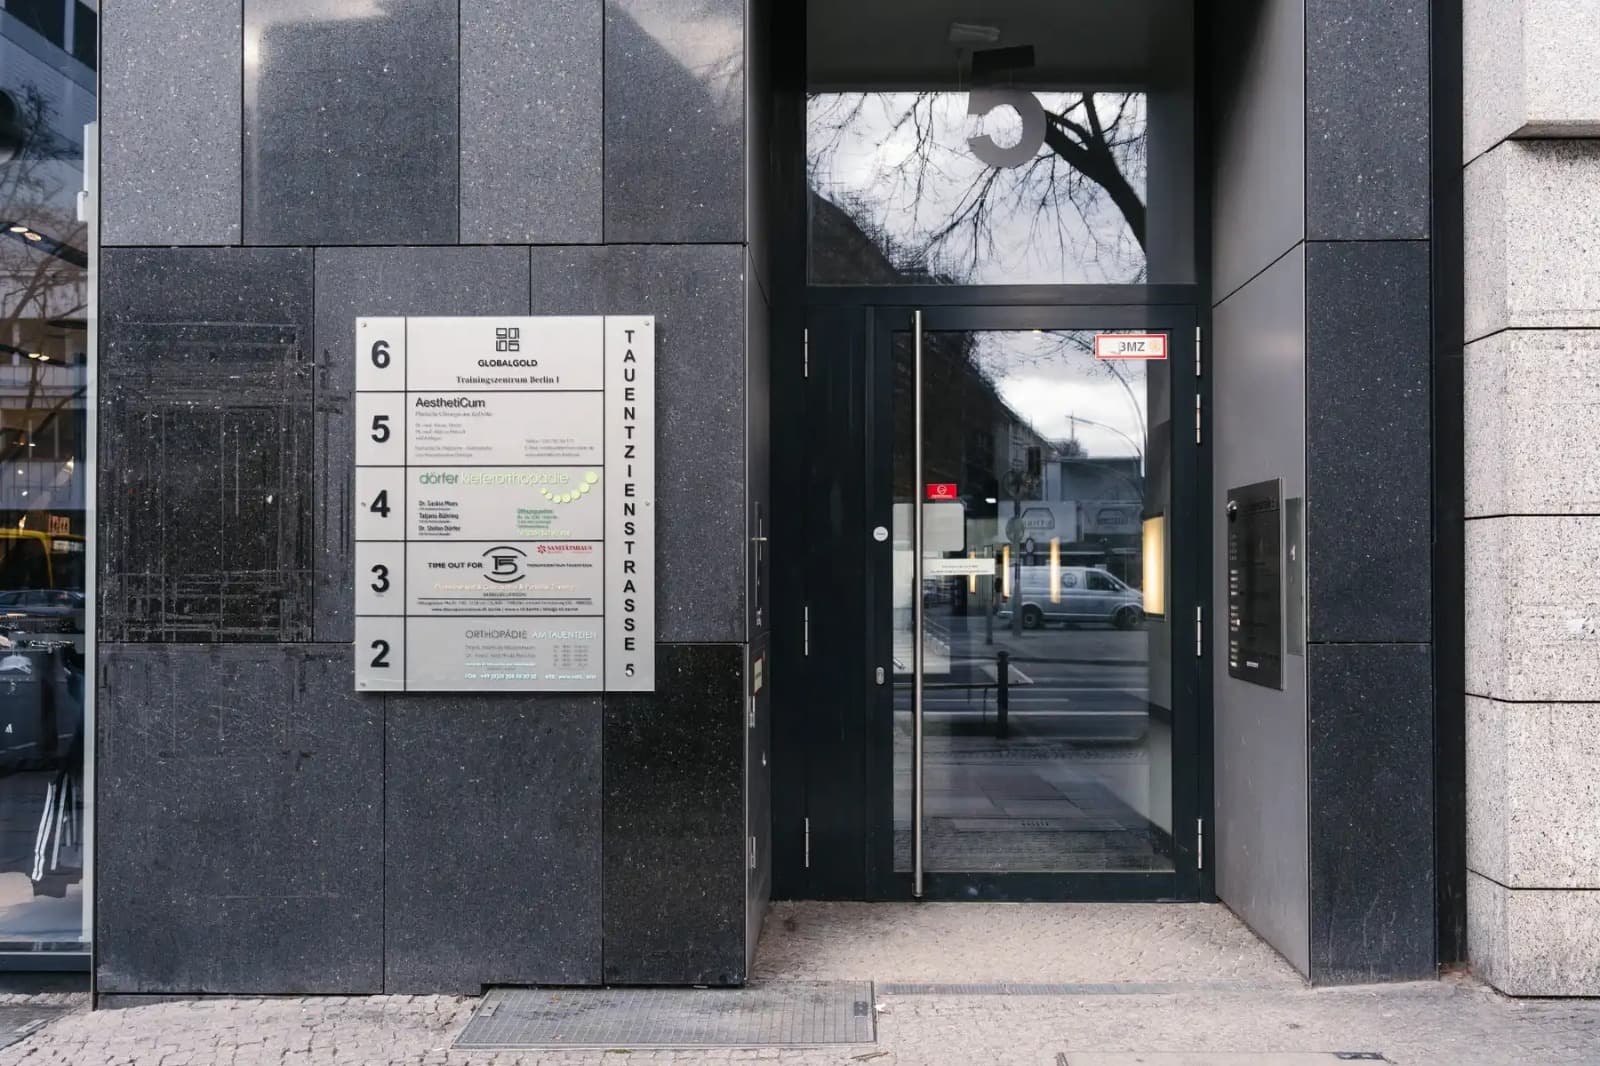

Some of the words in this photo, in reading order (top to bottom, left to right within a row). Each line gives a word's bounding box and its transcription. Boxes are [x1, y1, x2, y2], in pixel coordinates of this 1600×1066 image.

[966, 44, 1047, 169] 5
[371, 340, 390, 368] 6
[477, 359, 538, 367] GLOBALGOLD
[415, 397, 486, 408] AesthetiCum
[371, 415, 390, 443] 5
[419, 471, 459, 485] dörfer
[623, 330, 636, 651] TAUENTZIENSTRASSE
[370, 490, 390, 517] 4
[370, 564, 390, 592] 3
[465, 629, 528, 640] ORTHOPÄDIE
[370, 639, 390, 667] 2
[624, 664, 635, 678] 5
